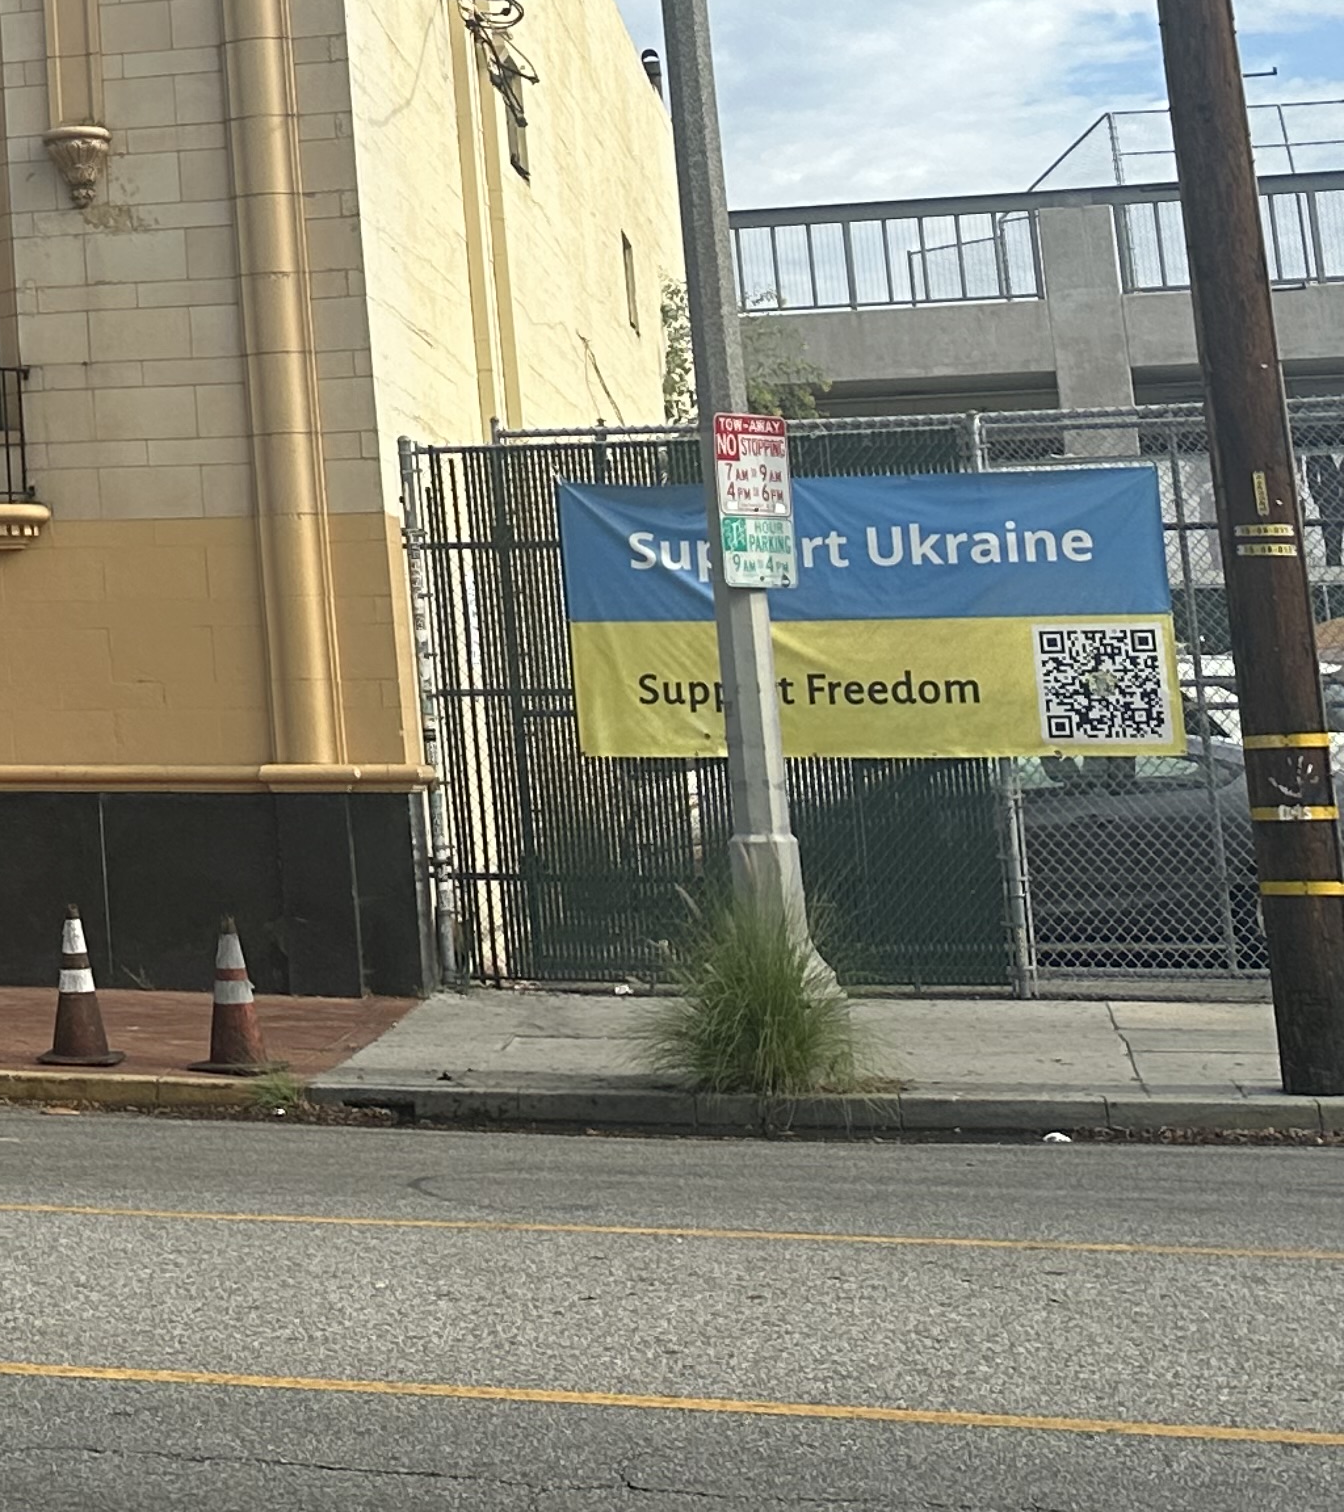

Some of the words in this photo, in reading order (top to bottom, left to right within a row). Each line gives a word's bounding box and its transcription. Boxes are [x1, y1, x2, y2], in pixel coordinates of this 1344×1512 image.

[717, 417, 782, 434] TOW-AWAY
[716, 433, 738, 457] NO
[740, 436, 786, 459] STOPPING
[725, 462, 733, 481] 7
[736, 468, 749, 482] AM
[759, 464, 768, 482] 9
[727, 481, 736, 501] 4
[737, 486, 752, 501] PM
[762, 483, 770, 502] 6
[754, 520, 784, 535] HOUR
[628, 530, 850, 583] Suprt
[866, 520, 1094, 567] Ukraine
[748, 533, 792, 555] PARKING
[733, 553, 741, 572] 9
[743, 559, 757, 572] AM
[766, 556, 774, 573] 4
[638, 673, 795, 713] Supt
[806, 669, 981, 706] Freedom
